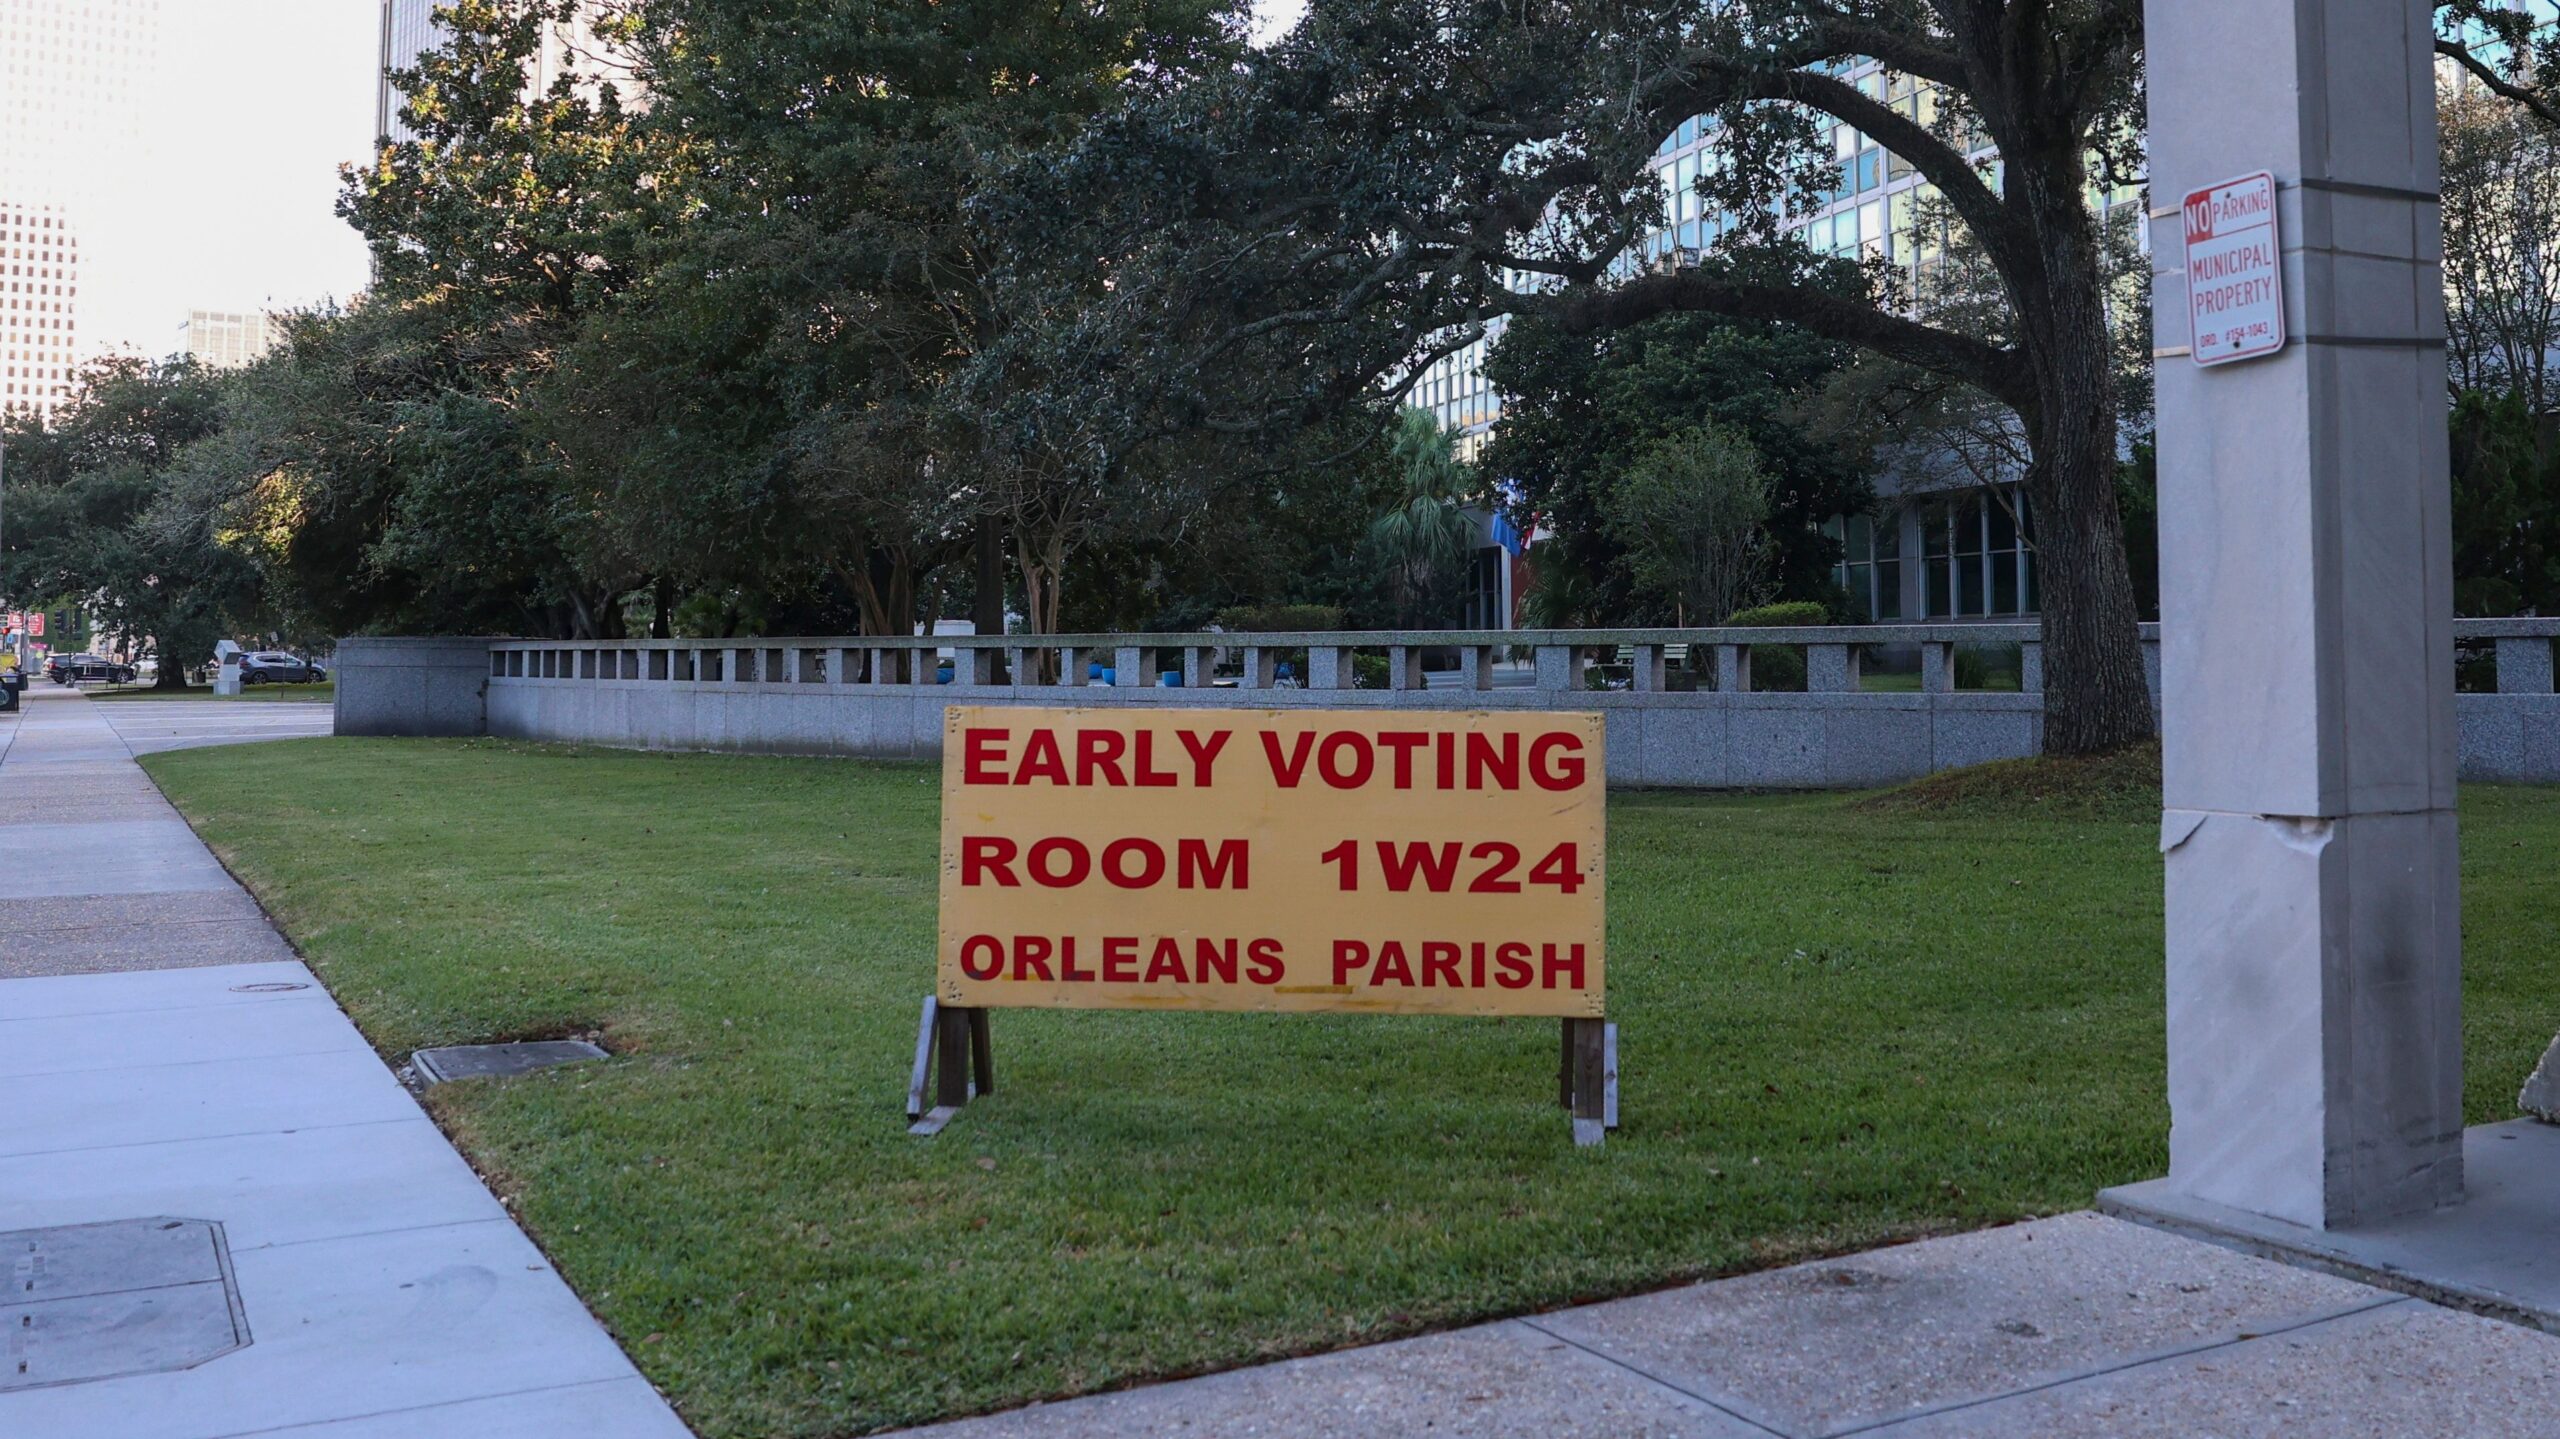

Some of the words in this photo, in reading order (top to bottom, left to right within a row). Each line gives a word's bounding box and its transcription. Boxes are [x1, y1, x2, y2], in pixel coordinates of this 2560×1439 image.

[2185, 201, 2209, 236] NO
[2213, 190, 2268, 223] PARKING
[2193, 243, 2271, 283] MUNICIPAL
[2196, 276, 2271, 315] PROPERTY
[964, 728, 1231, 787] EARLY
[1260, 731, 1584, 791] VOTING
[962, 836, 1249, 889] ROOM
[1321, 840, 1584, 894] 1W24
[960, 934, 1285, 985] ORLEANS
[1333, 940, 1585, 989] PARISH
